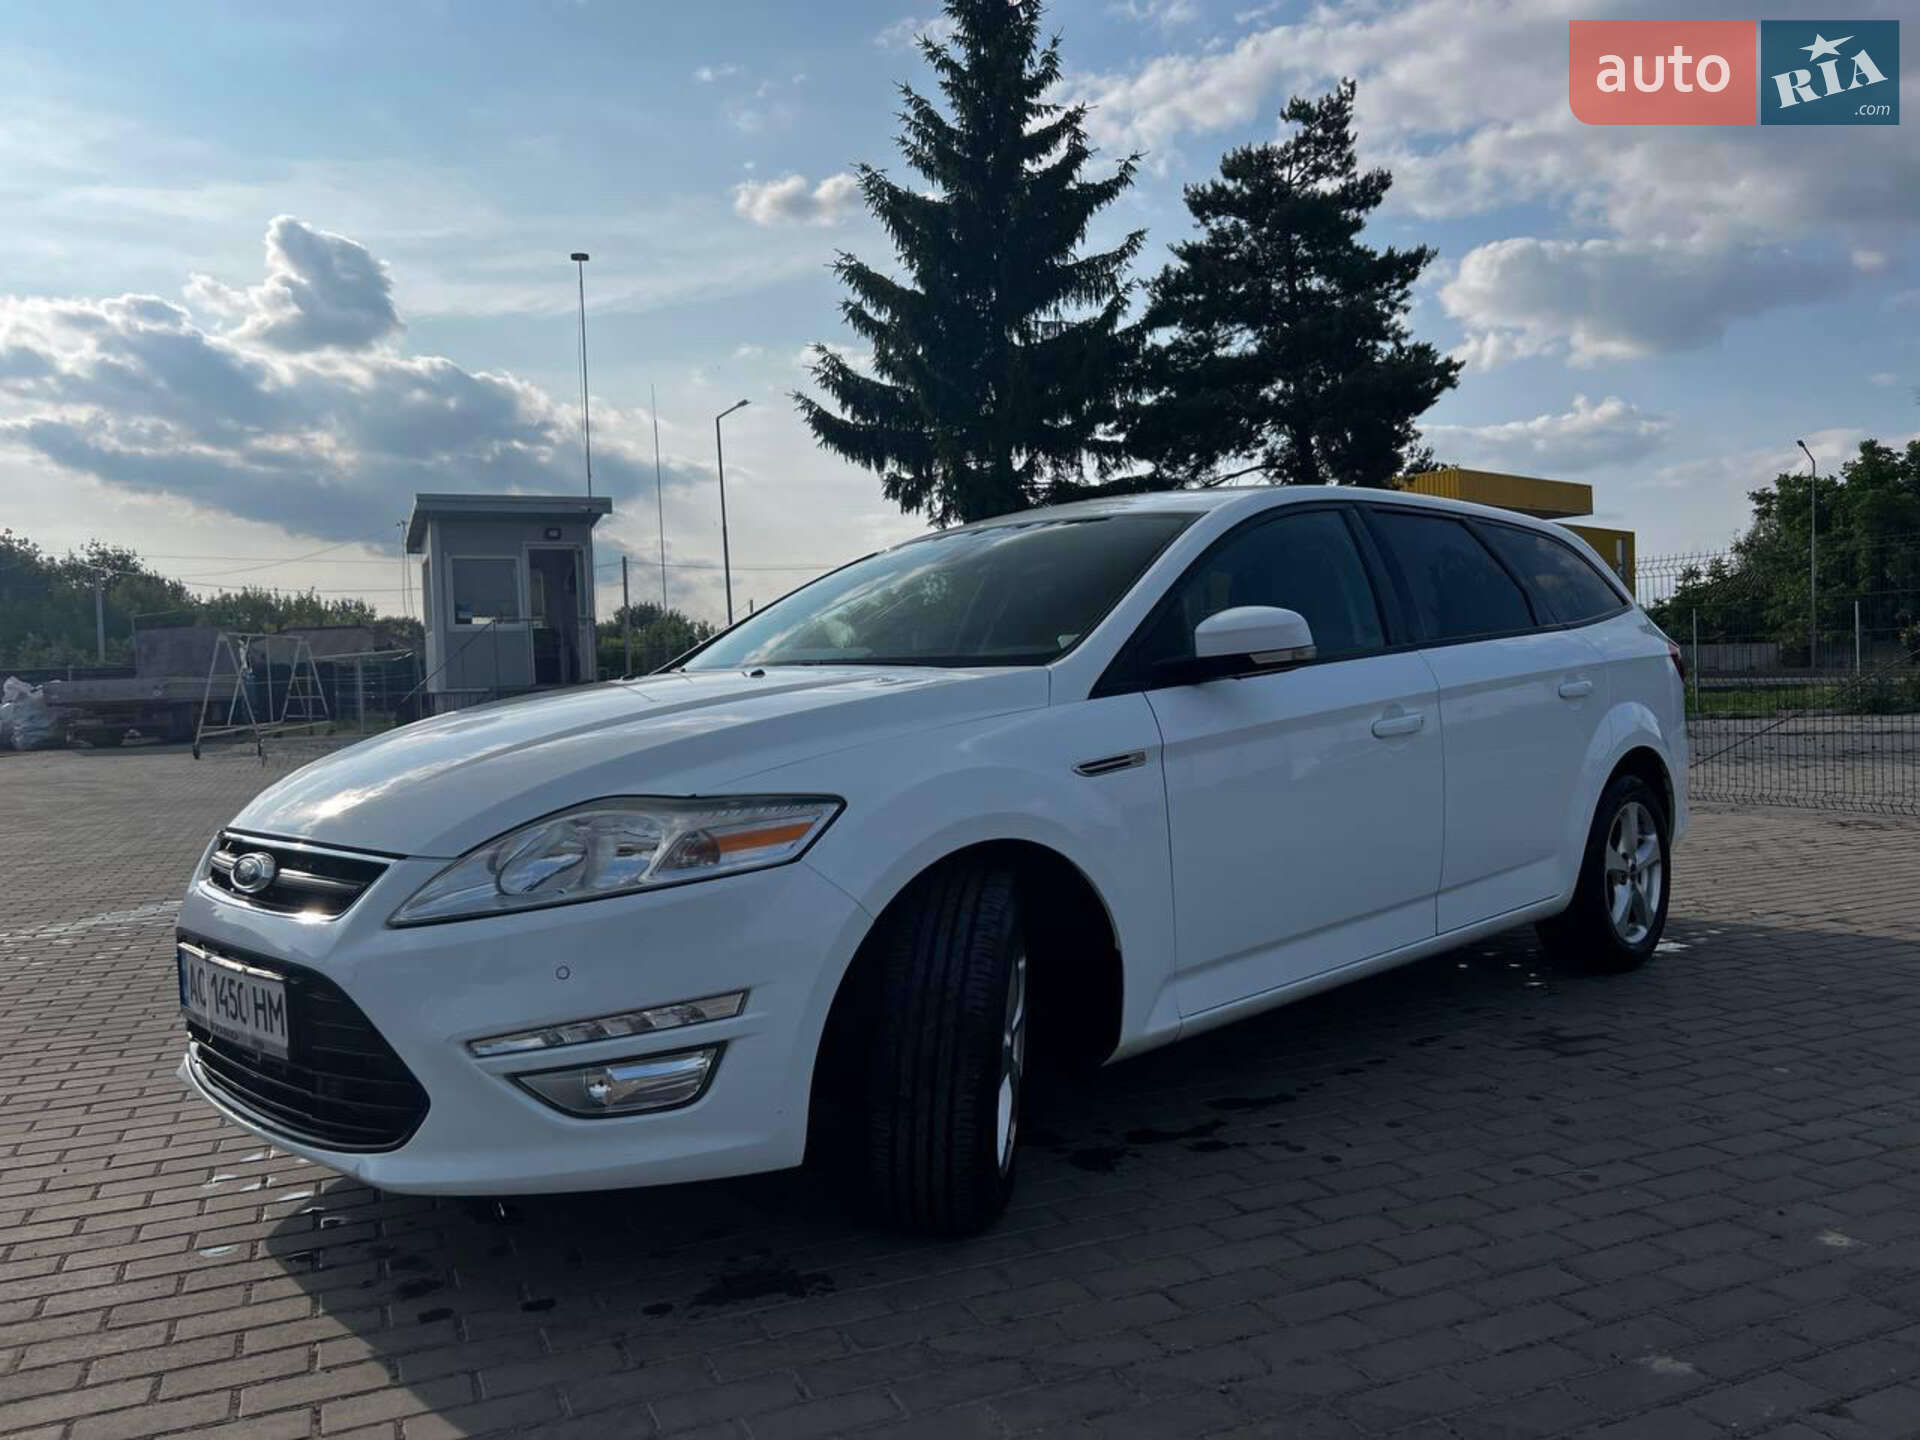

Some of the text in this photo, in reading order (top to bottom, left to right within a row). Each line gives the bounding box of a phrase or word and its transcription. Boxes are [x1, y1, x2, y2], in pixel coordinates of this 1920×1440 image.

[190, 962, 207, 1008] AC
[211, 972, 250, 1025] 1450
[252, 985, 285, 1038] HM
